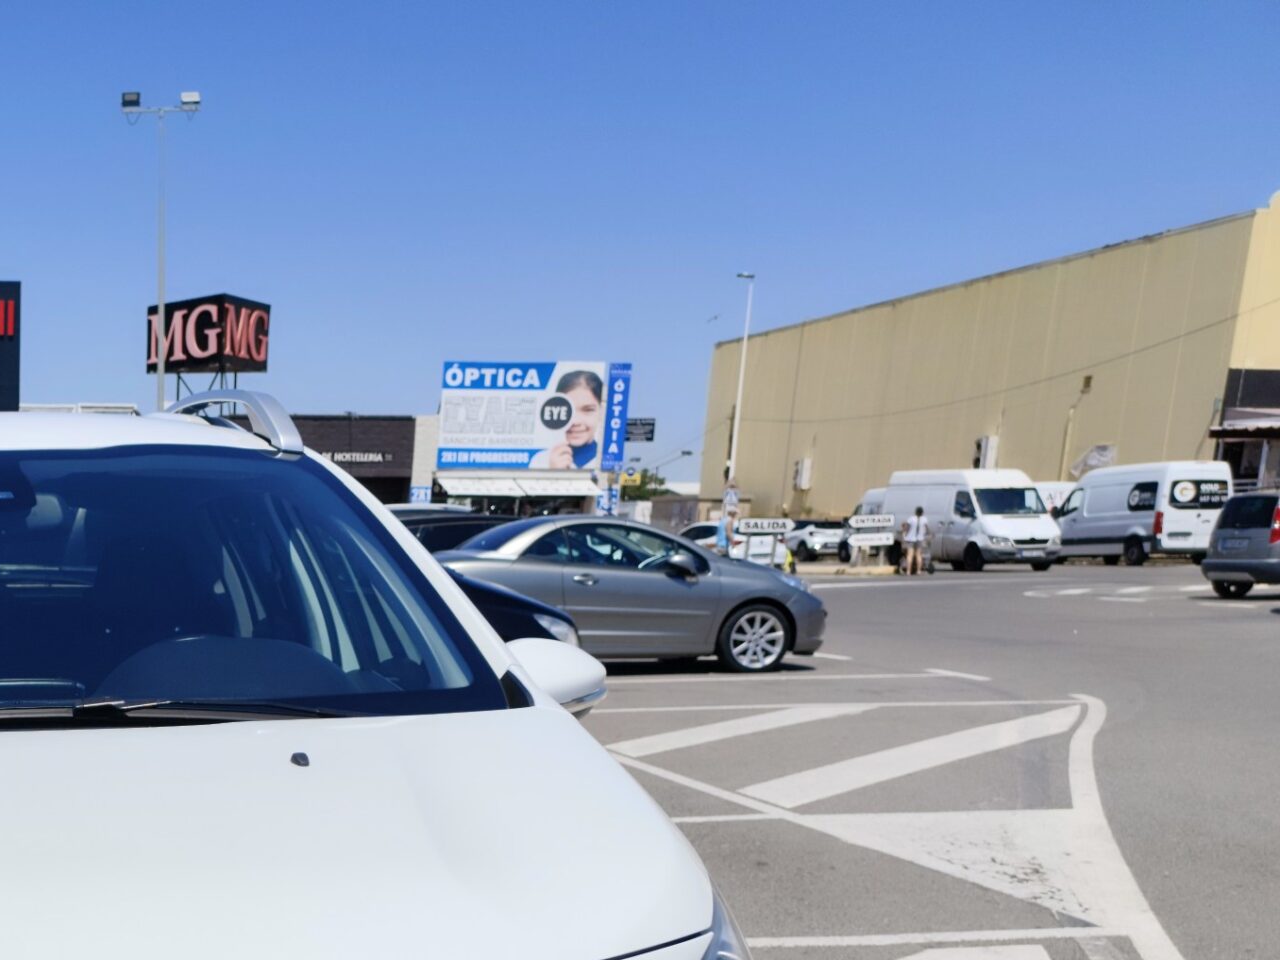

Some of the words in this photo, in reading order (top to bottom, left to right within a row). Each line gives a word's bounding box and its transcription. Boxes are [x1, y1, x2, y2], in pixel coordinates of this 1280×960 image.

[147, 303, 222, 364] MG
[223, 302, 269, 362] MG
[444, 363, 541, 388] ÓPTICA
[543, 405, 568, 421] EYE
[743, 520, 788, 531] SALIDA
[854, 516, 892, 525] ENTRADA
